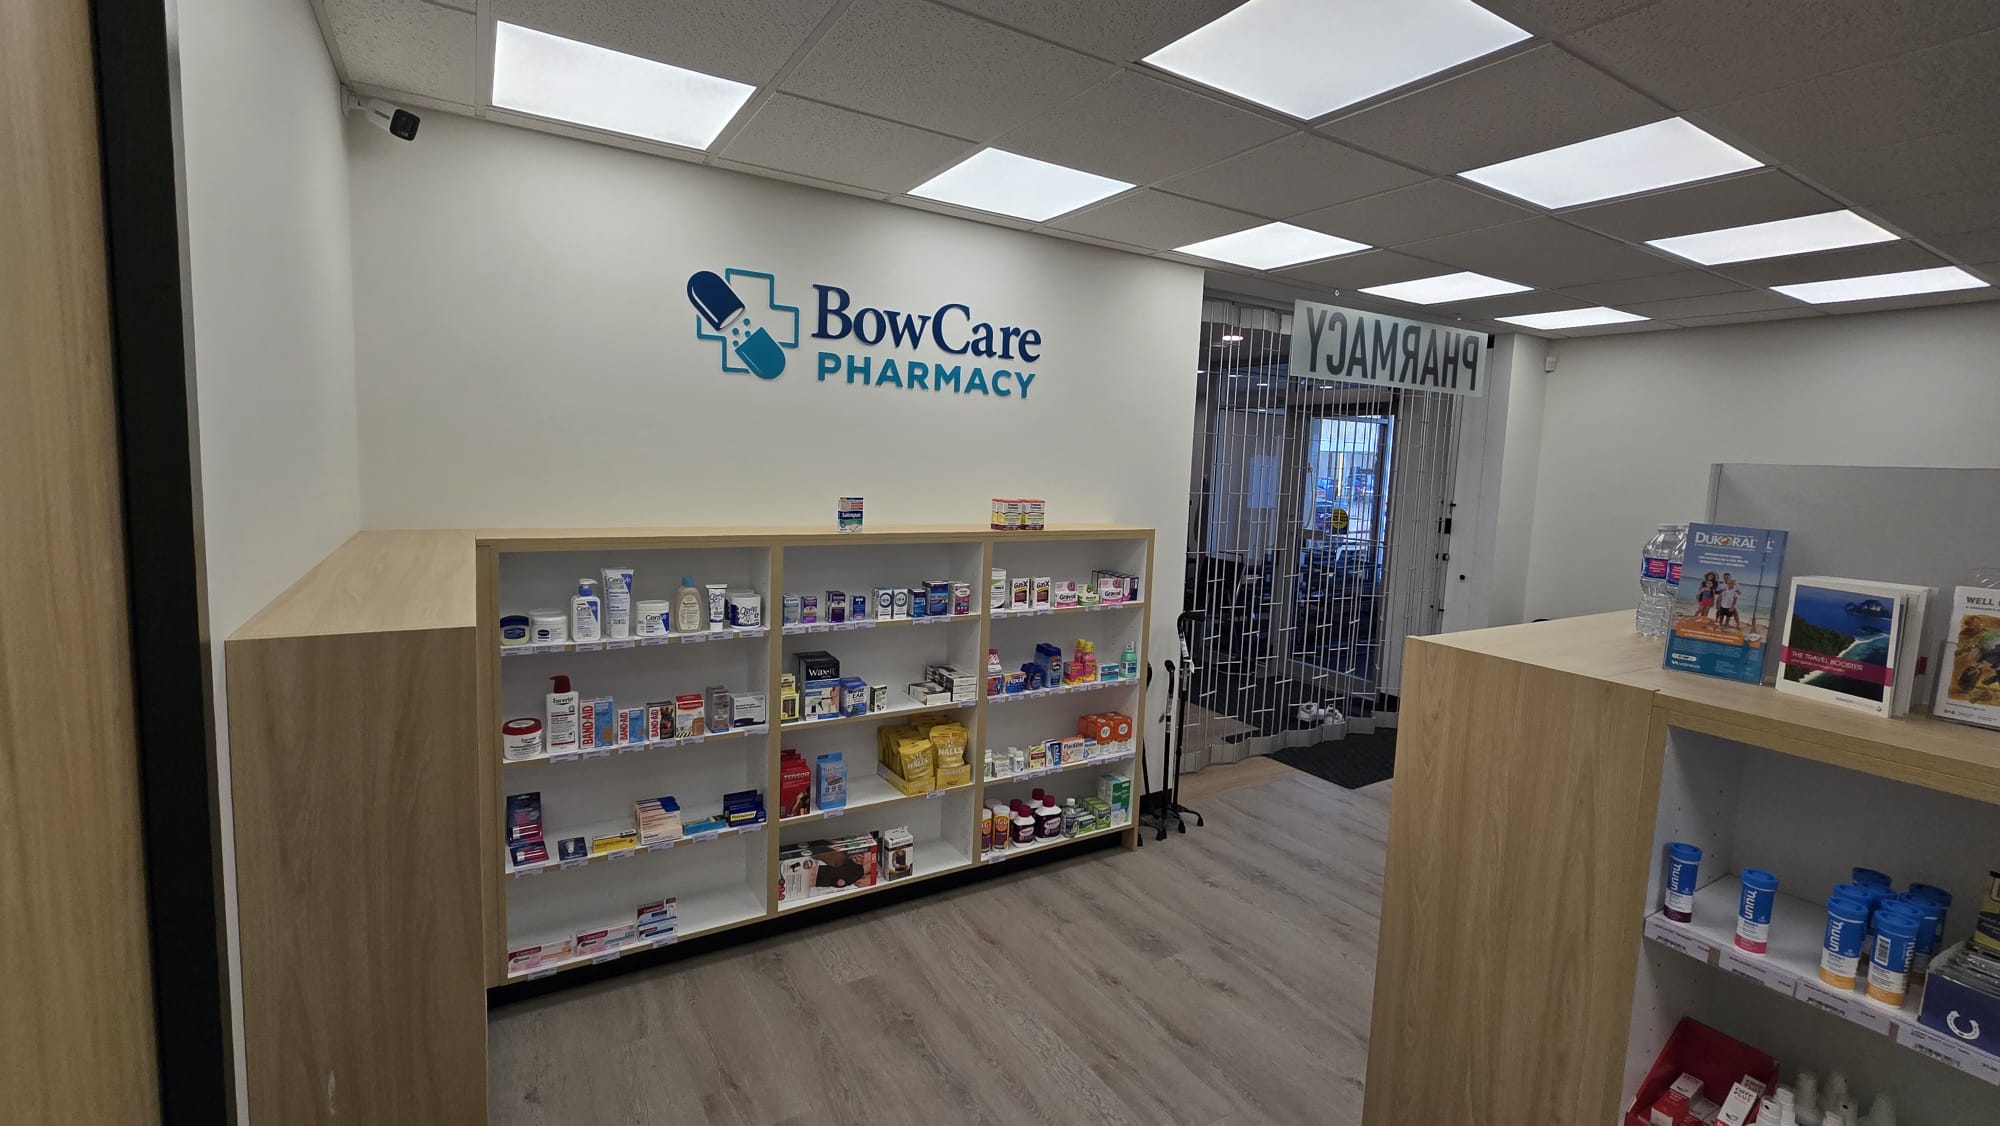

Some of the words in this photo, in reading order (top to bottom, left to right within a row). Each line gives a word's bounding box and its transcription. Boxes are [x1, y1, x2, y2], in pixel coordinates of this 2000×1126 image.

[811, 283, 1042, 362] BowCare
[817, 352, 1036, 399] PHARMACY
[1695, 532, 1757, 549] DUKORAL
[1966, 596, 1995, 606] WELL
[1792, 650, 1804, 659] THE
[1805, 653, 1829, 665] TRAVEL
[1830, 658, 1864, 671] BOOSTER
[582, 705, 594, 746] BAND-AID
[620, 712, 629, 741] BAND-AID
[907, 757, 929, 769] HALLS
[938, 747, 963, 756] HALLS
[1671, 863, 1683, 891] nuun
[1744, 890, 1758, 919] nuun
[1828, 921, 1844, 951] nuun
